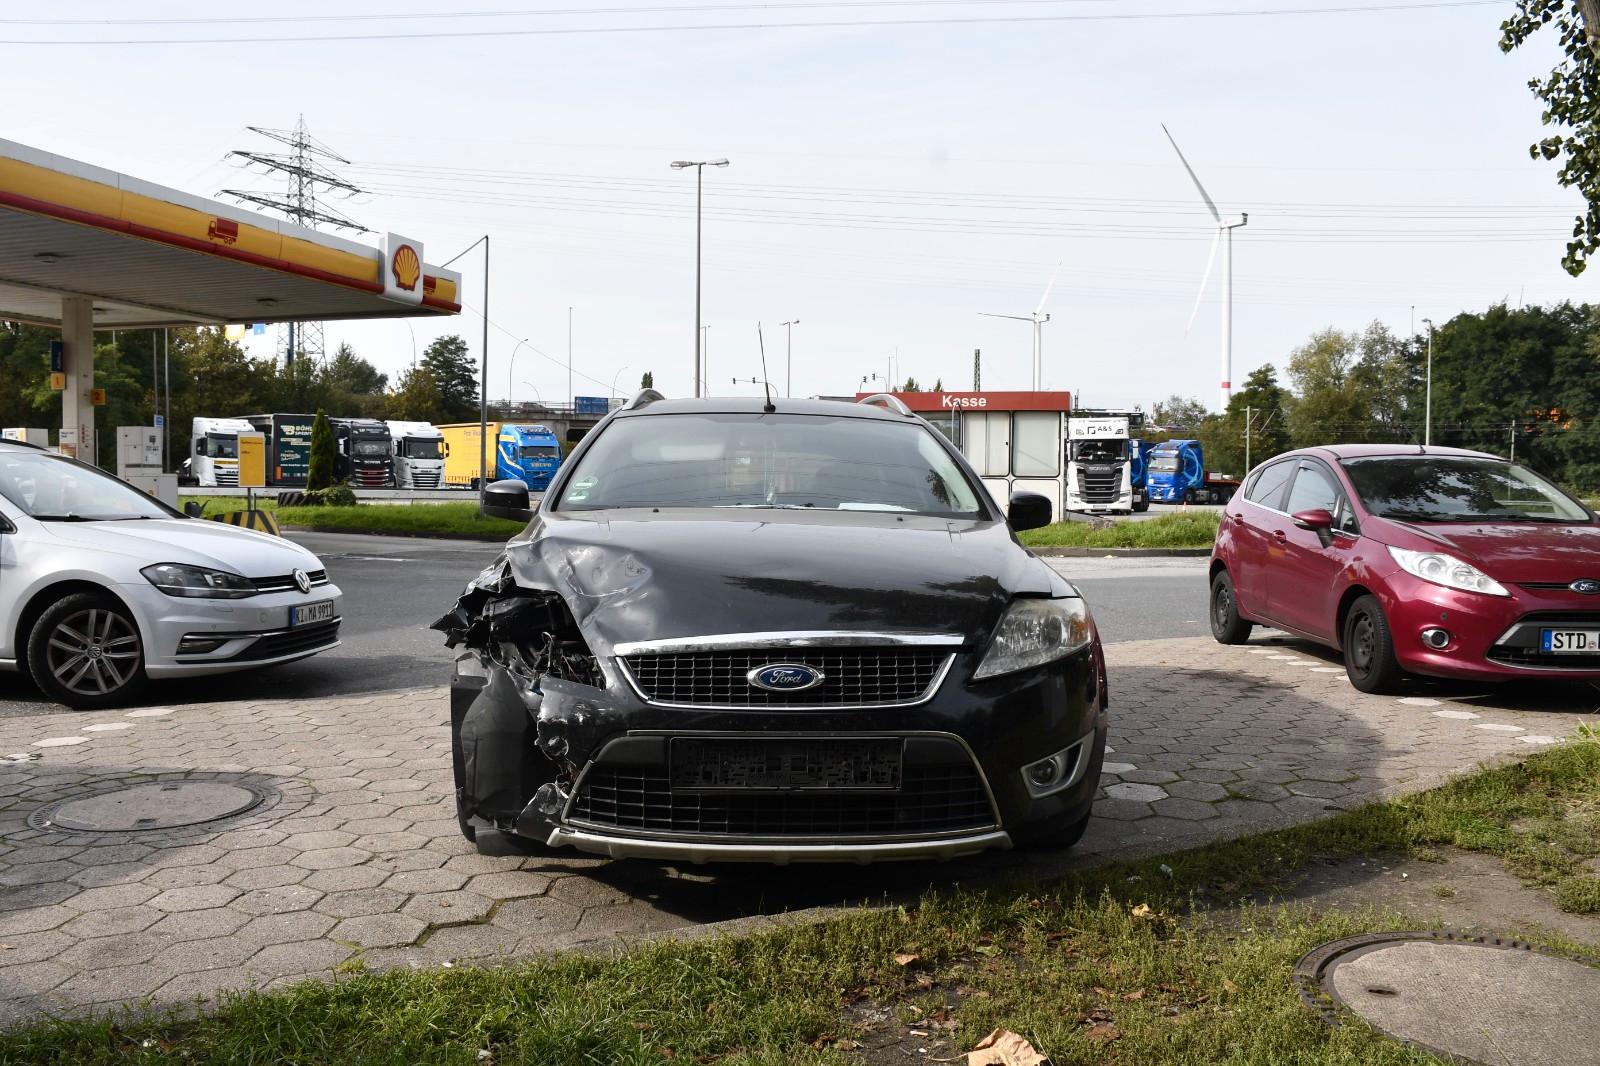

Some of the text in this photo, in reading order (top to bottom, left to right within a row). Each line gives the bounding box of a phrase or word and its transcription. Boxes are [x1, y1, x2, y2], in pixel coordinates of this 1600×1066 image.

[942, 395, 987, 407] Kasse
[309, 606, 317, 621] MA
[1553, 632, 1587, 649] STD
[769, 669, 803, 683] Ford
